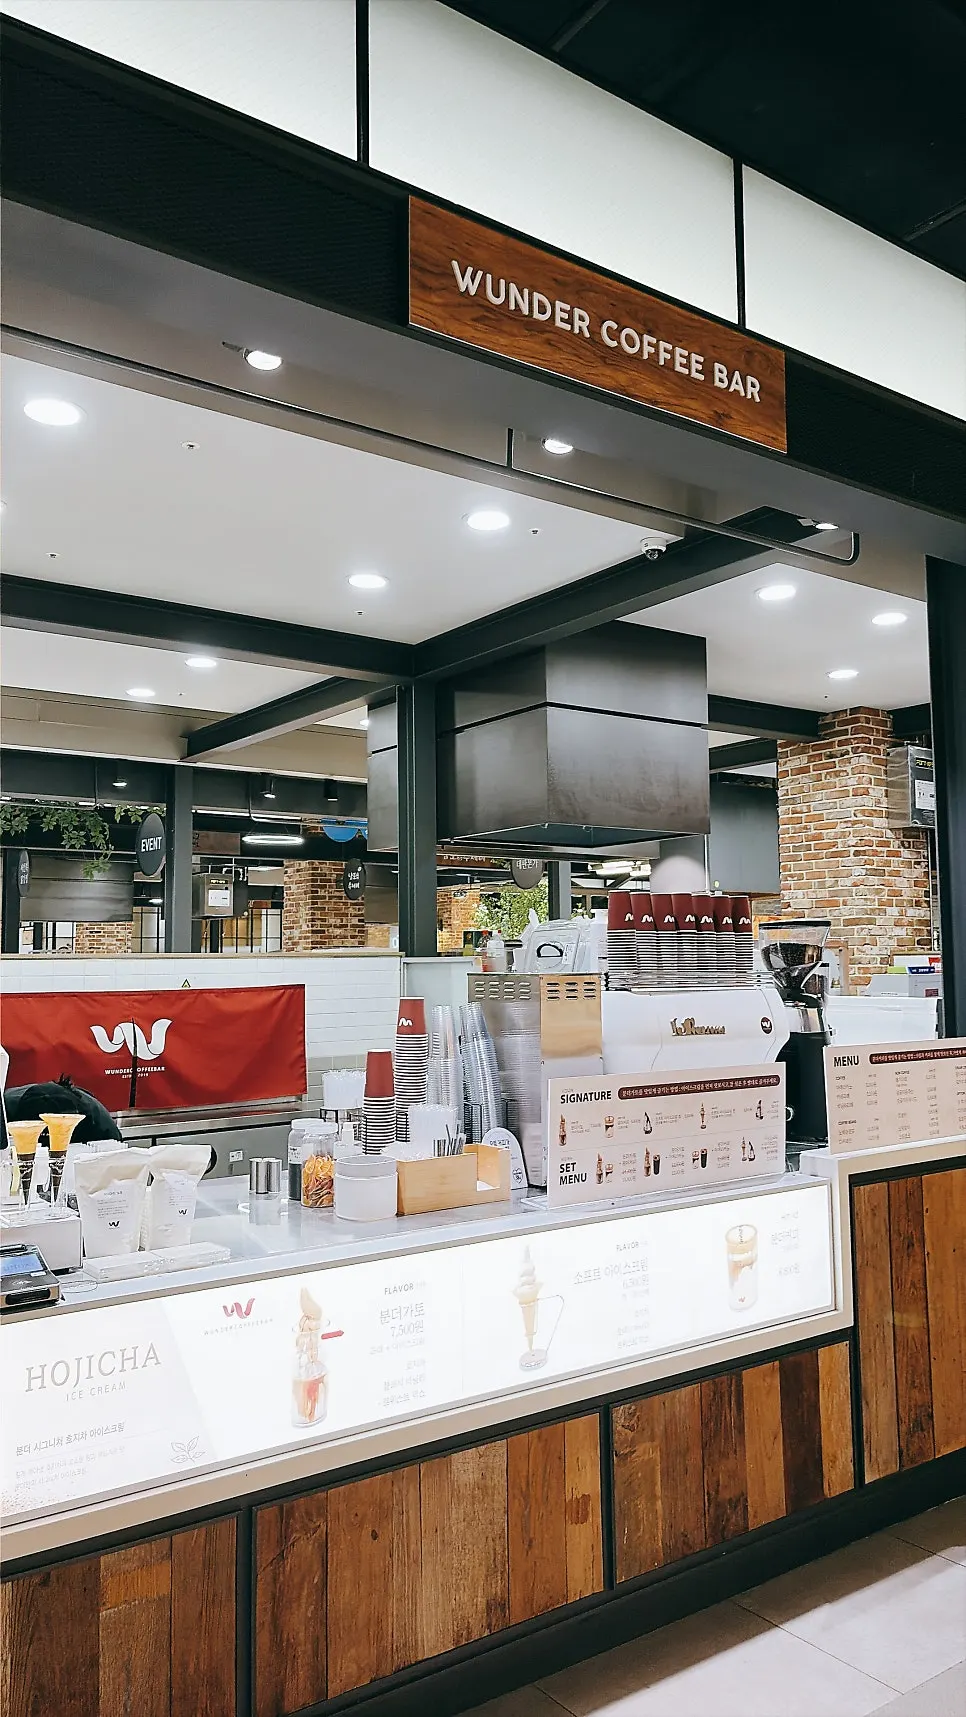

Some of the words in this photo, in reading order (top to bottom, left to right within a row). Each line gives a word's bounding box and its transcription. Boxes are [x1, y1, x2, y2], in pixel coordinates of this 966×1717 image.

[450, 259, 591, 338] WUNDER
[600, 319, 705, 381] COFFEE
[713, 362, 762, 403] BAR
[141, 836, 163, 853] EVENT
[833, 1055, 860, 1067] MENU
[560, 1090, 612, 1104] SIGNATURE
[559, 1162, 577, 1174] SET
[559, 1173, 588, 1186] MENU
[616, 1241, 640, 1252] FLAVOR
[573, 1267, 602, 1285] 소프트
[604, 1256, 648, 1278] 아이스크림
[384, 1282, 414, 1296] FLAVOR
[379, 1302, 425, 1326] 분더가토
[390, 1319, 425, 1339] 7,500원
[25, 1341, 162, 1393] HOJICHA
[66, 1390, 84, 1402] ICE
[89, 1380, 127, 1397] CREAM
[15, 1442, 31, 1457] 분더
[33, 1436, 63, 1452] 시그니처
[65, 1430, 88, 1445] 호지차
[89, 1420, 126, 1438] 아이스크림
